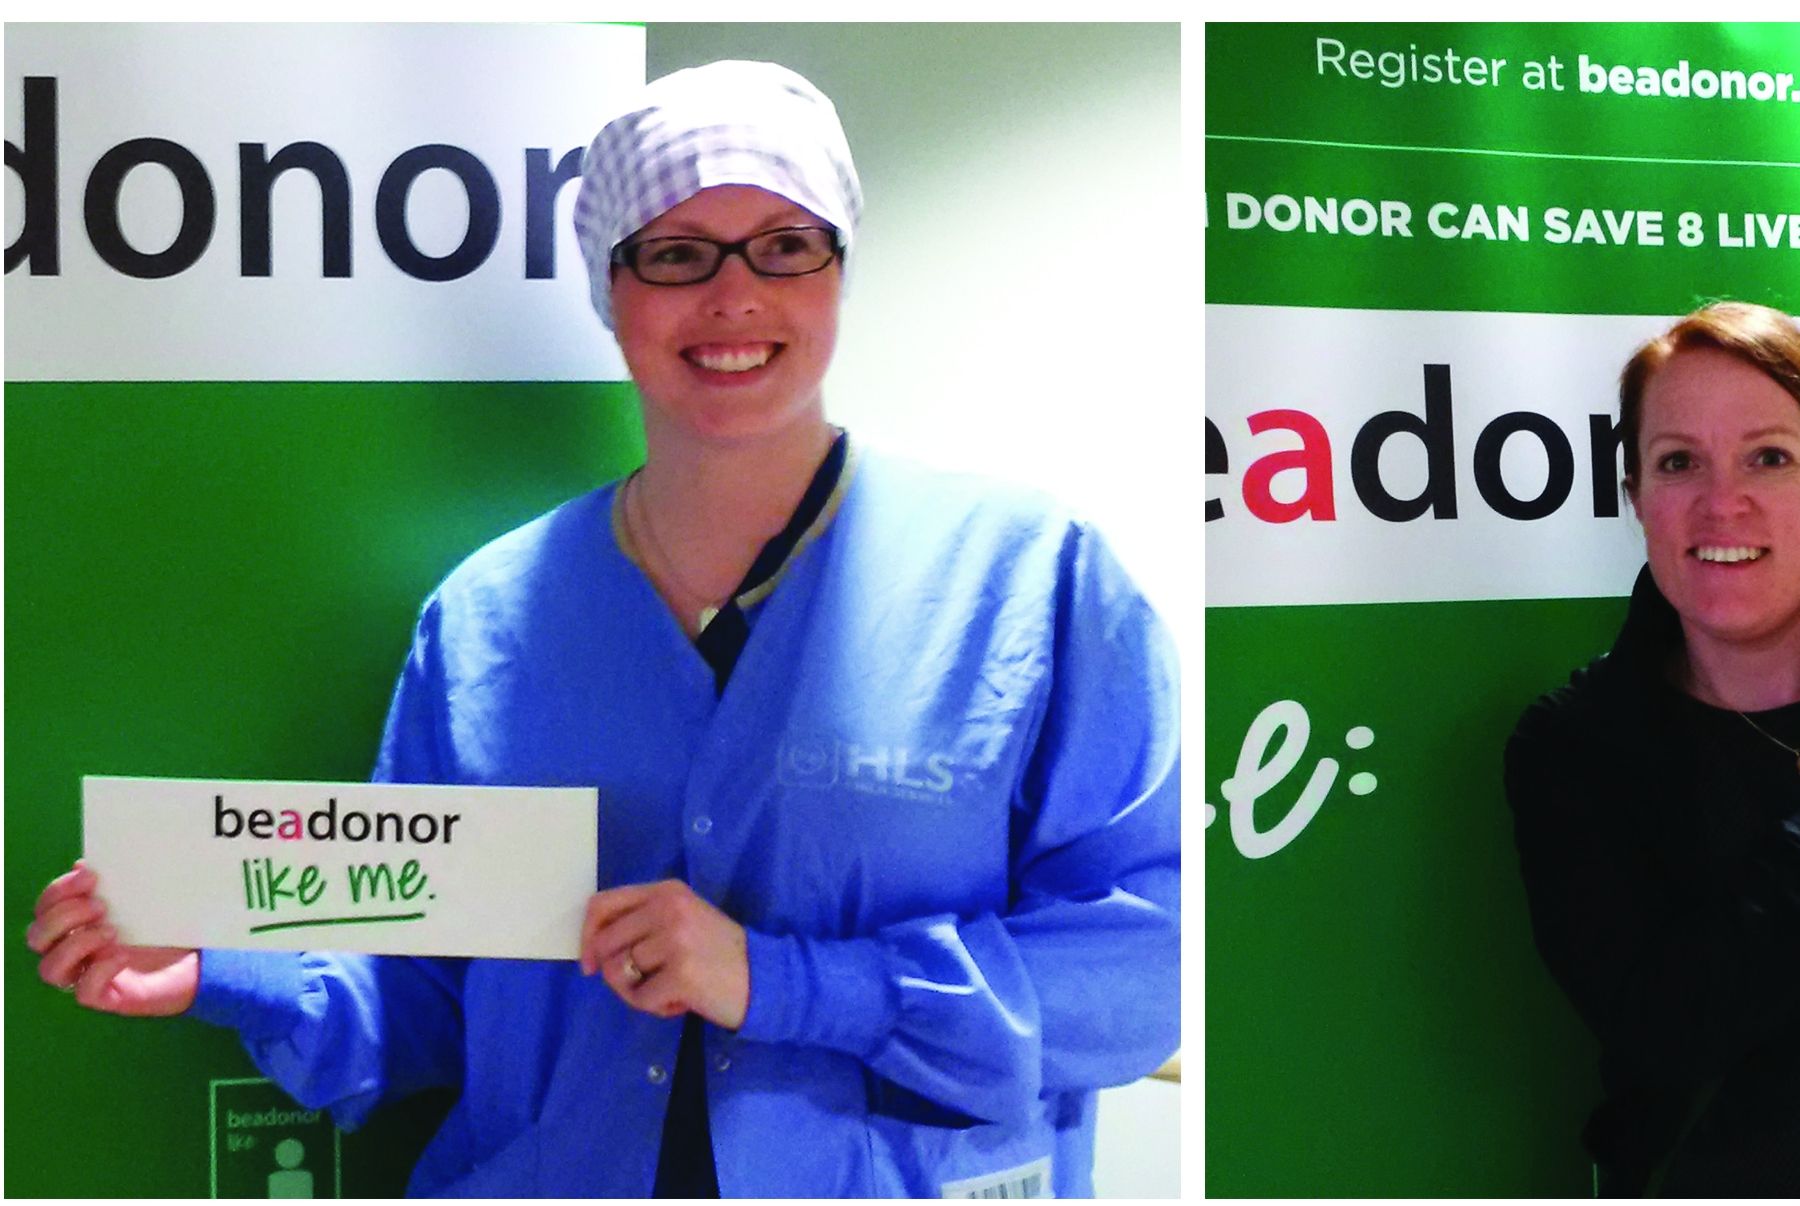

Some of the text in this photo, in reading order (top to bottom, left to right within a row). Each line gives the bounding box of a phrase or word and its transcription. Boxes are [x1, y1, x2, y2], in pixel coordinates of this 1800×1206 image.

[1317, 37, 1507, 89] Register
[1522, 55, 1566, 91] at
[1226, 192, 1413, 237] DONOR
[1427, 202, 1530, 242] CAN
[1543, 207, 1664, 246] SAVE
[1677, 211, 1704, 246] 8
[849, 745, 953, 793] HLS
[214, 795, 461, 844] beadonor
[242, 857, 436, 911] like me.
